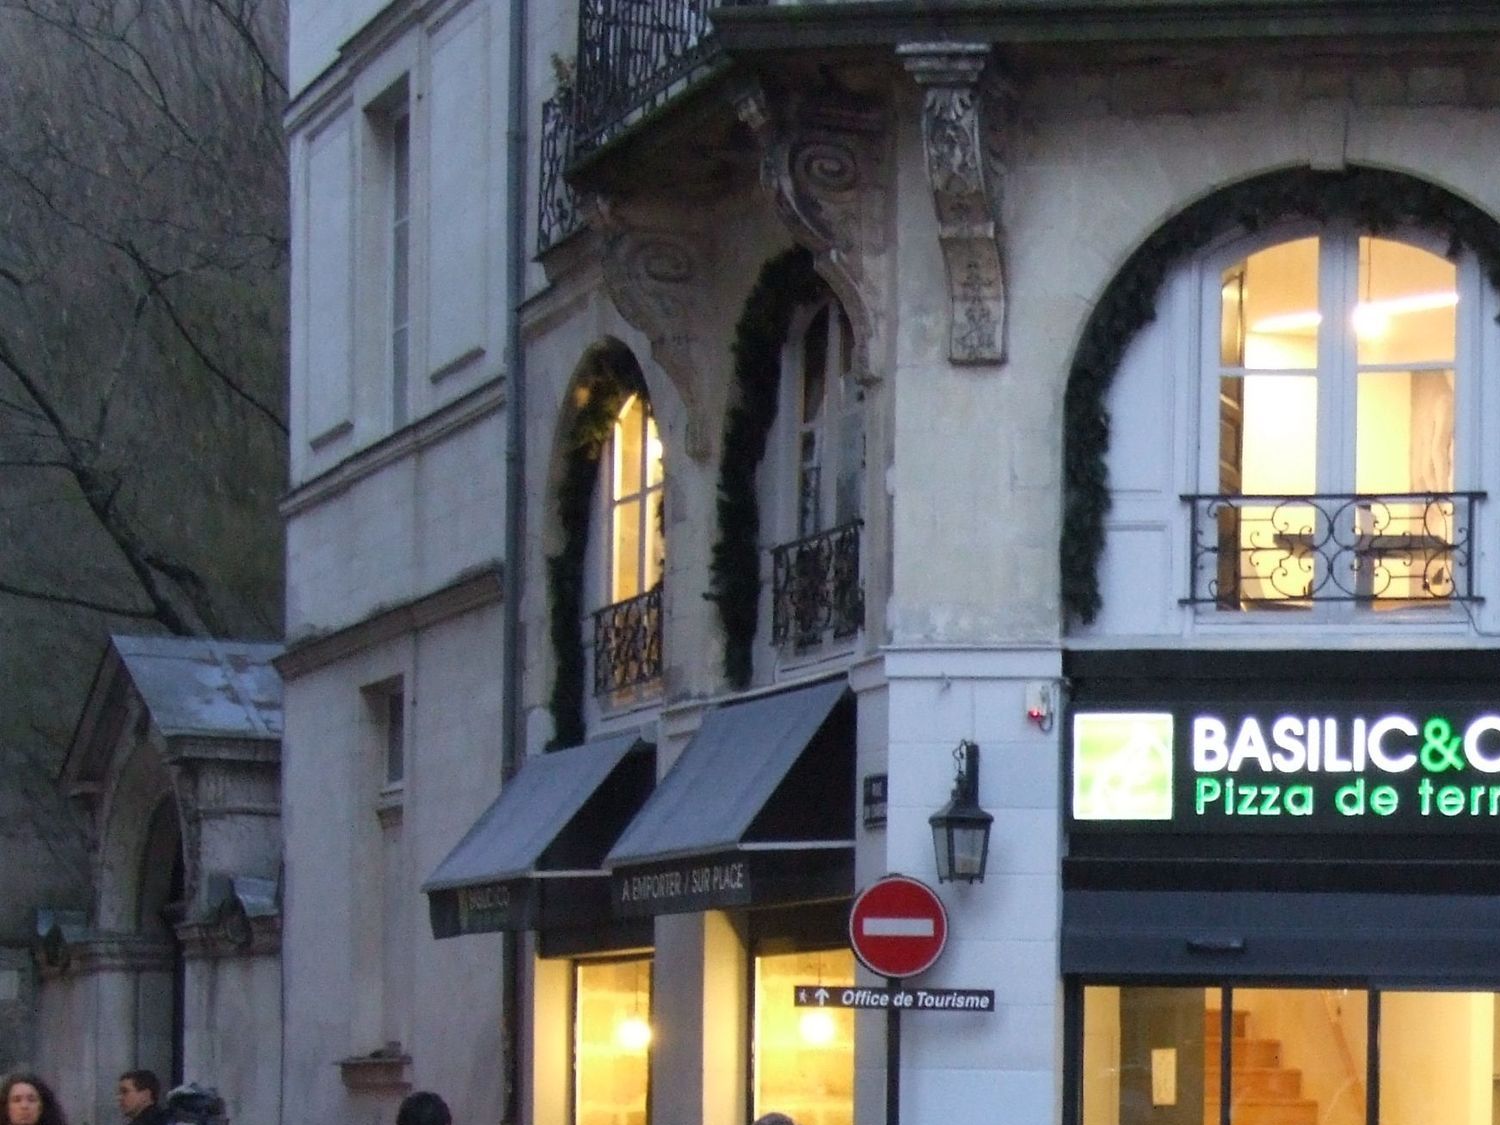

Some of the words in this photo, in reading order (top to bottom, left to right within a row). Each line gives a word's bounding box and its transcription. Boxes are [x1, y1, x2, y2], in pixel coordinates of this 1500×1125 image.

[1196, 777, 1314, 816] Pizza
[1335, 777, 1399, 816] de
[842, 989, 889, 1006] Office
[893, 992, 913, 1008] de
[916, 991, 990, 1009] Tourisme
